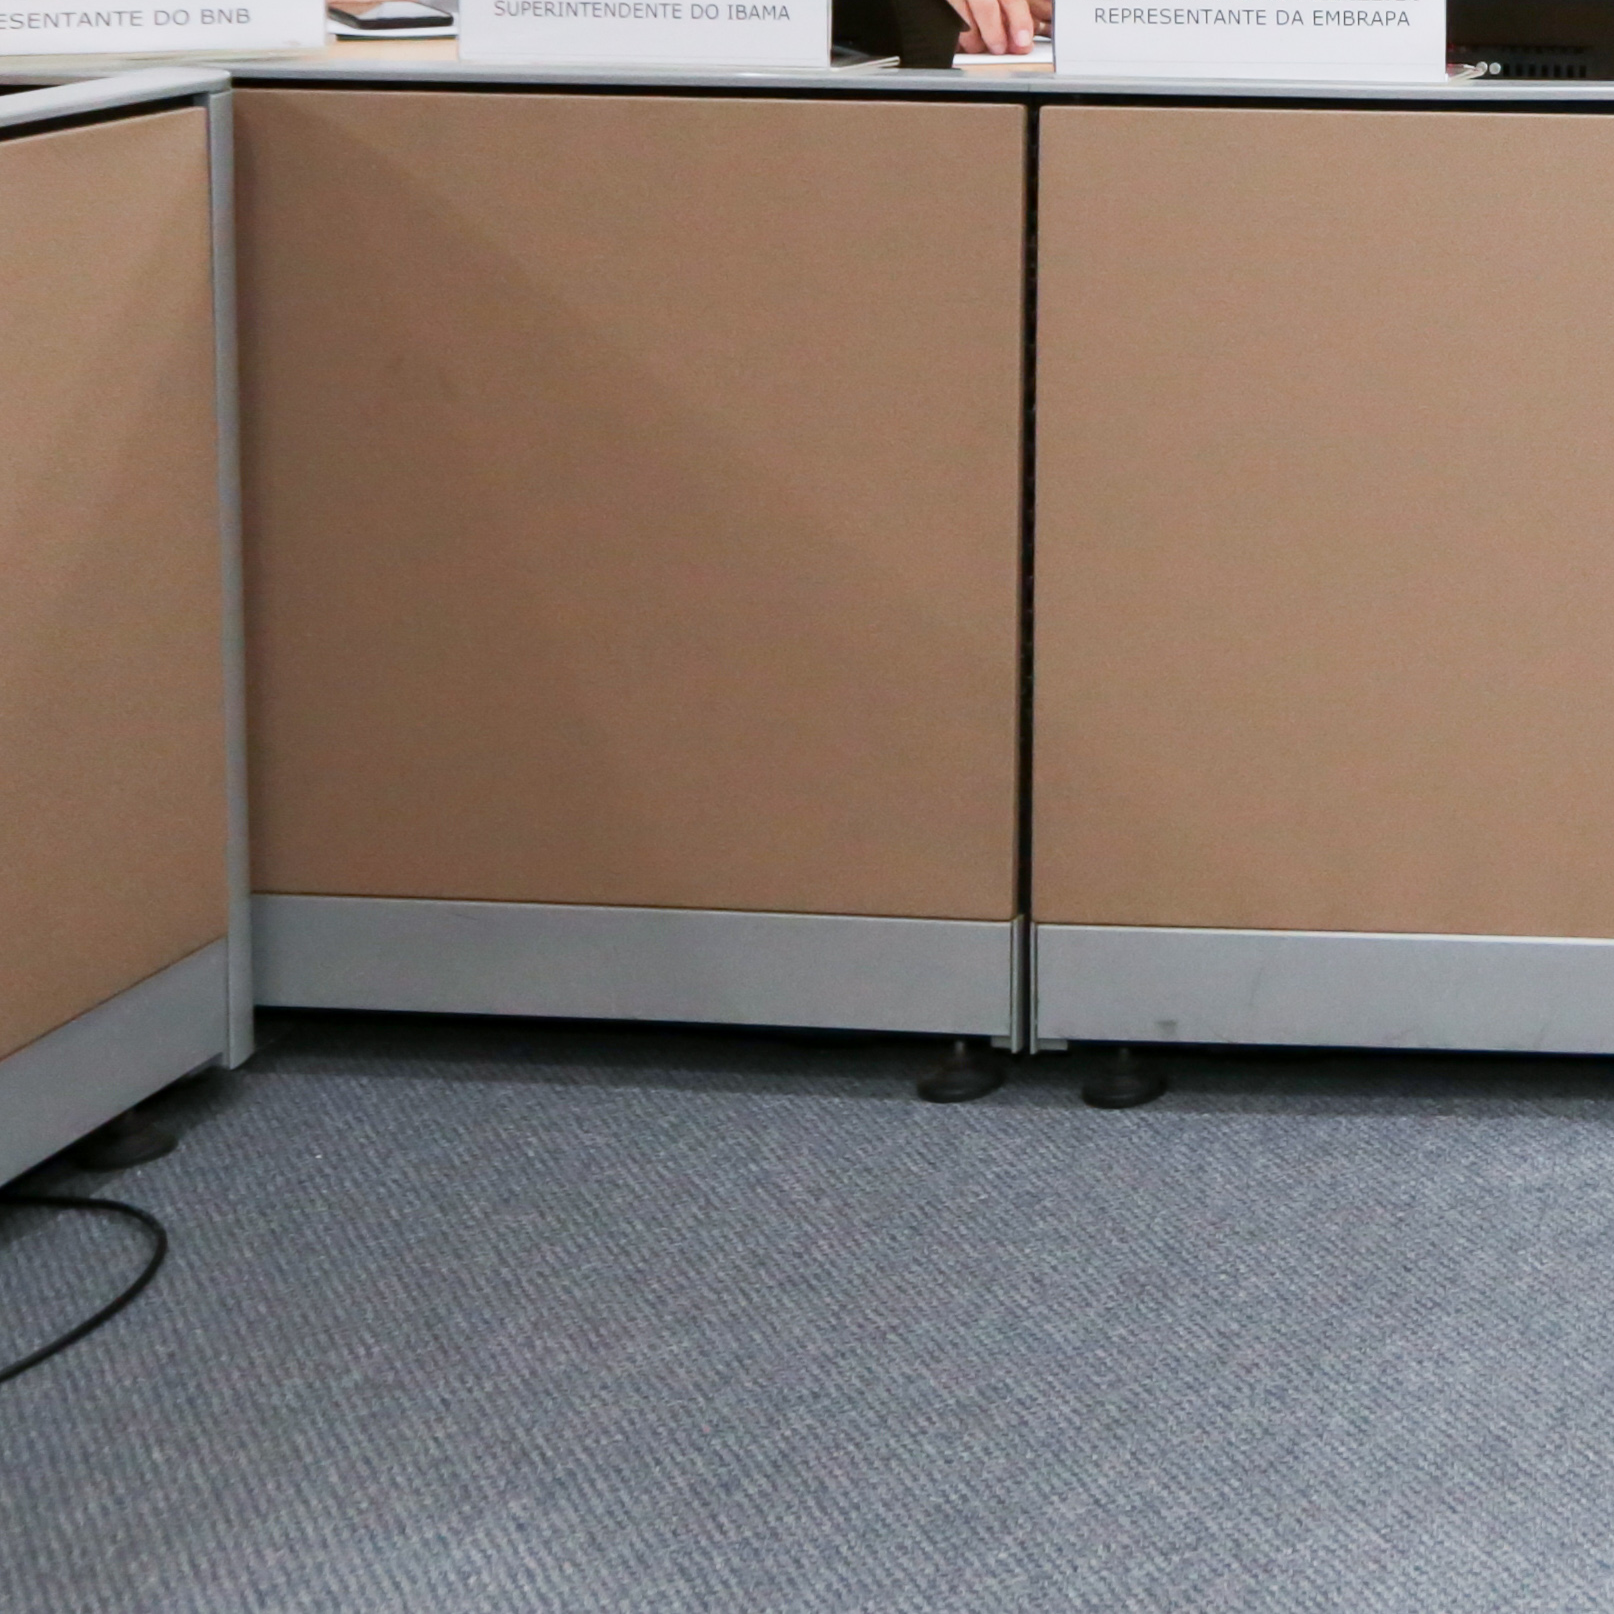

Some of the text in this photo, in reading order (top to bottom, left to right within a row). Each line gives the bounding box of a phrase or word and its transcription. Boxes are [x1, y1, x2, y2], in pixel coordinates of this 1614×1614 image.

[153, 8, 191, 27] DO
[200, 7, 251, 25] BNB
[493, 0, 791, 21] SUPERINTENDENTE DO IBAMA
[1094, 7, 1410, 27] REPRESENTANTE DA EMBRAPA
